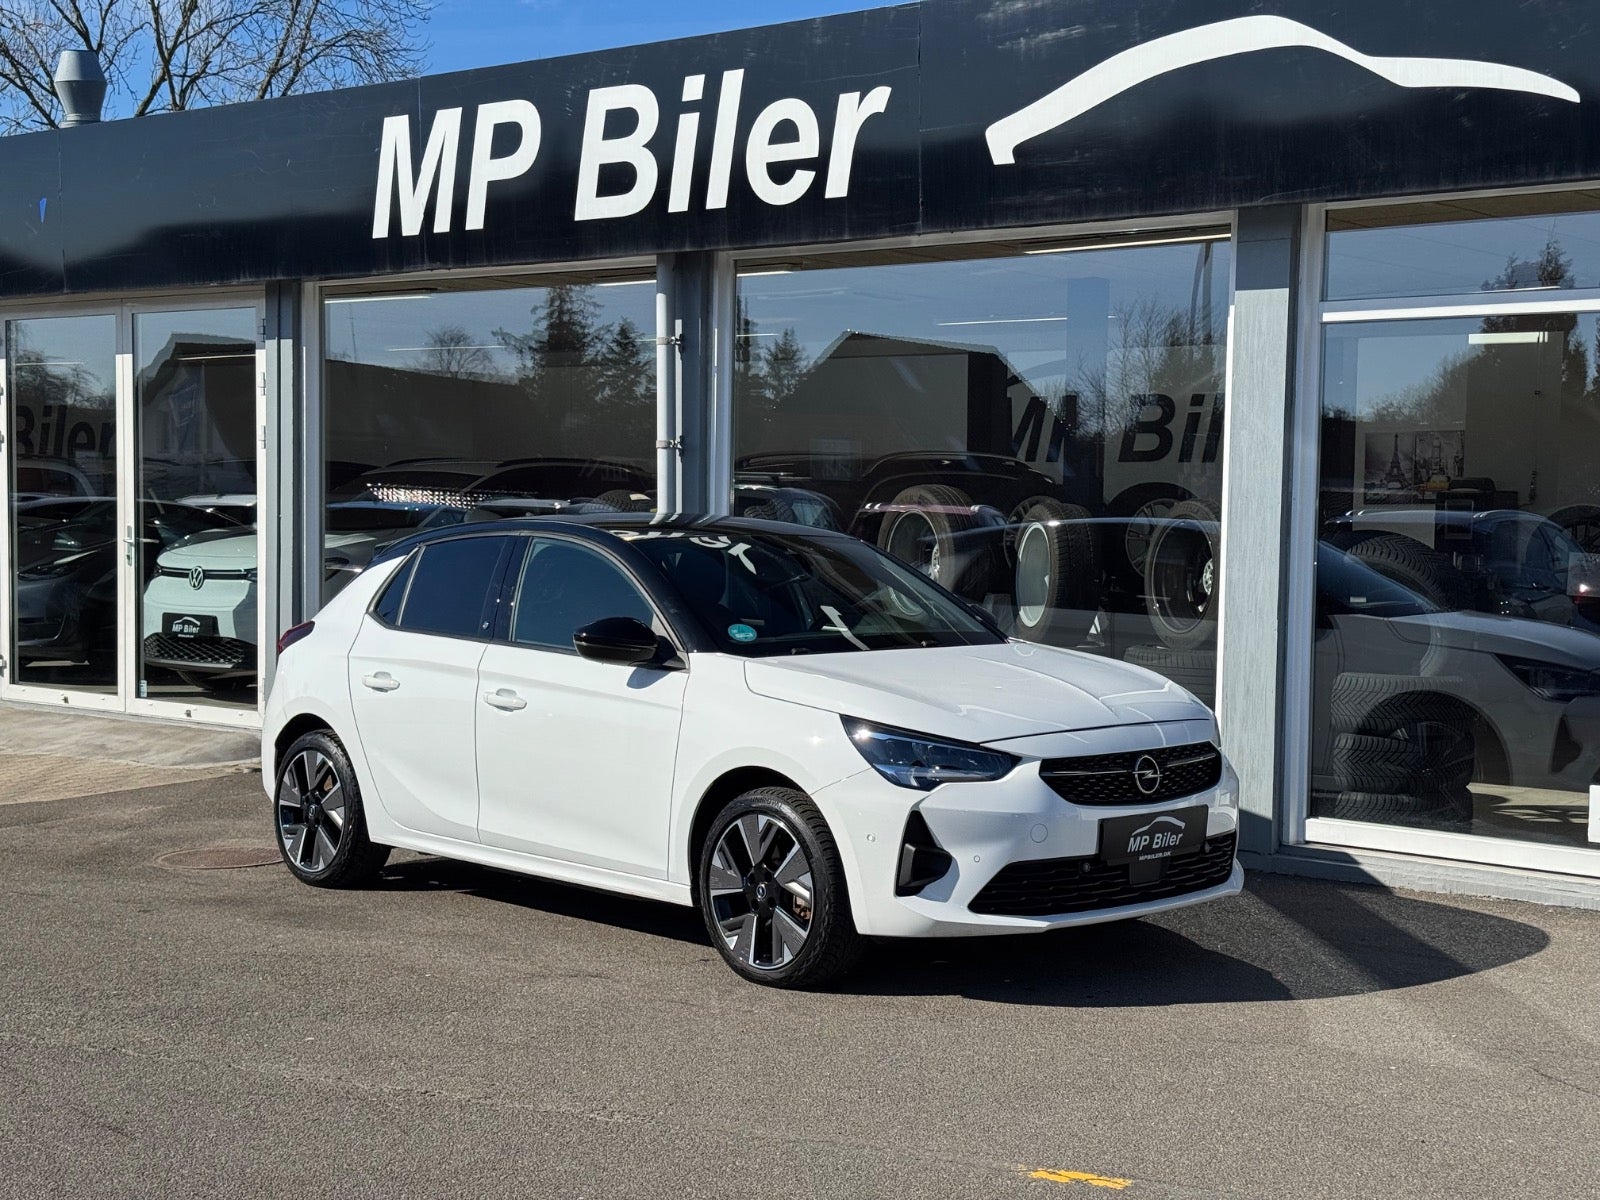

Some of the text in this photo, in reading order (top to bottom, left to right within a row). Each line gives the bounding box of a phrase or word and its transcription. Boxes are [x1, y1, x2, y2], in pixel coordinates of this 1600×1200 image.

[372, 68, 892, 239] MP Biler
[172, 623, 199, 634] MP Biler
[1127, 831, 1184, 853] MP Biler
